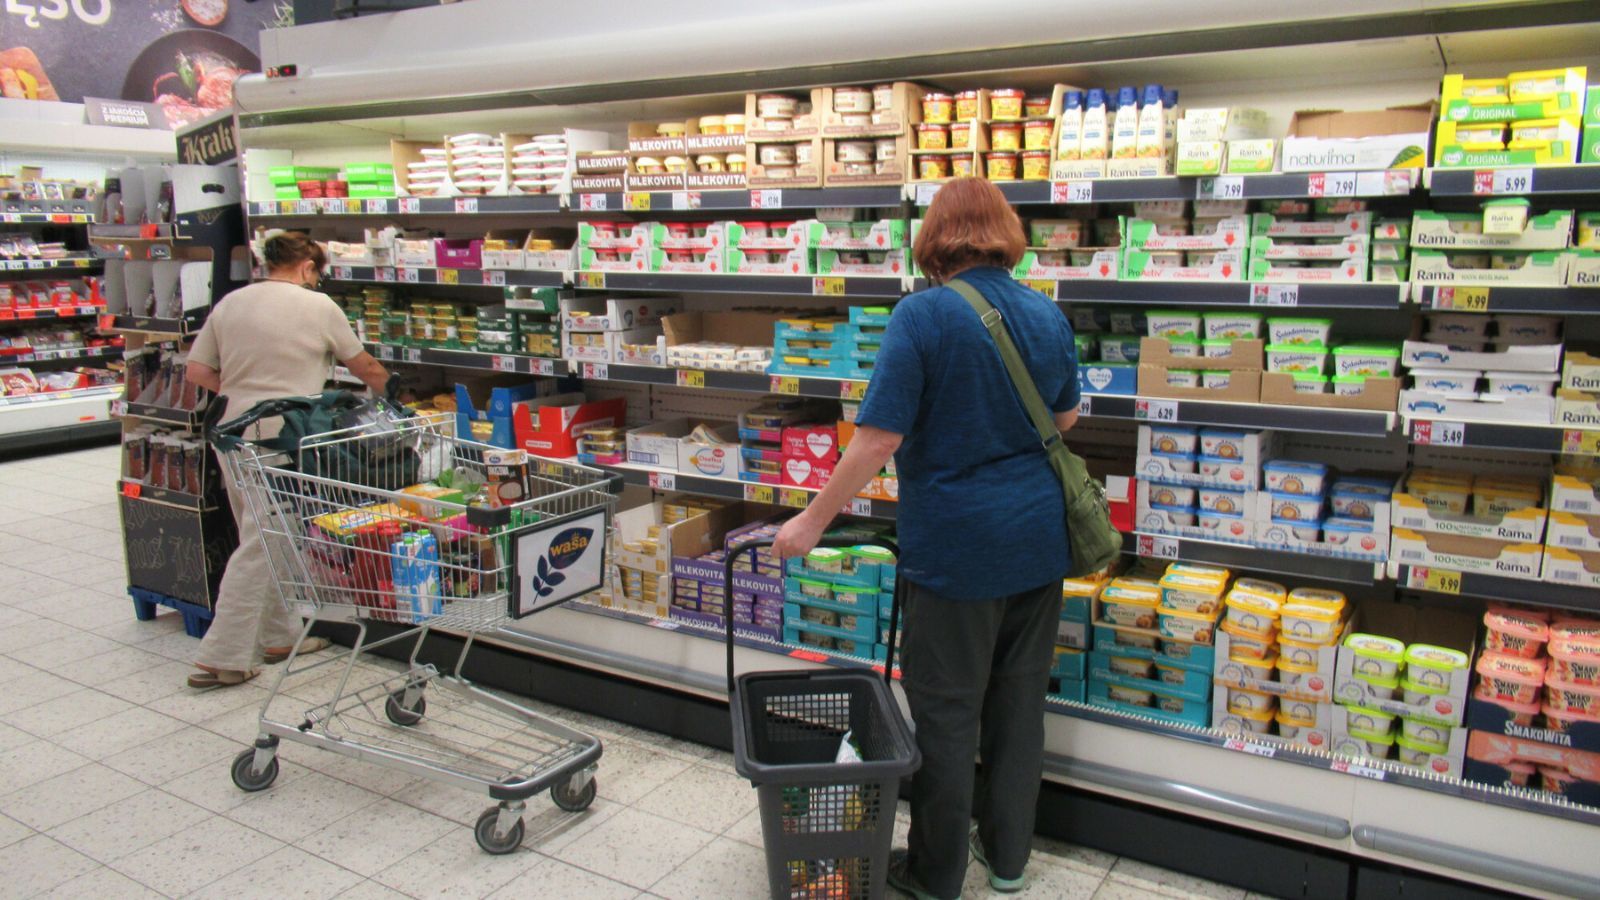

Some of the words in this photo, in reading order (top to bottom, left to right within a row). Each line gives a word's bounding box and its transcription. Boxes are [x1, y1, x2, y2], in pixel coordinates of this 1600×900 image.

[104, 114, 149, 125] PREMIUM
[1473, 109, 1517, 119] ORIGINAL
[629, 139, 684, 152] MLEKOVITA
[688, 135, 746, 149] MLEKOVITA
[578, 157, 628, 168] MLEKOVITA
[1290, 148, 1355, 167] naturima
[1466, 153, 1510, 164] ORIGINAL
[1056, 170, 1082, 179] Rama
[1110, 168, 1138, 178] Rama
[572, 178, 622, 189] MLEKOVITA
[629, 175, 683, 186] MLEKOVITA
[688, 174, 746, 186] MLEKOVITA
[1506, 177, 1526, 192] 5.99
[1225, 184, 1241, 197] 7.99
[1336, 181, 1353, 194] 7.99
[1076, 189, 1090, 200] 7.59
[1131, 240, 1166, 248] ProActiv
[1418, 232, 1456, 245] Rama
[1015, 269, 1047, 277] ProActiv
[1128, 270, 1163, 278] ProActiv
[1416, 270, 1455, 282] Rama
[1466, 296, 1487, 308] 9.99
[1572, 376, 1600, 388] Ram
[1158, 408, 1173, 420] 6.29
[1414, 424, 1430, 432] VAT
[1442, 430, 1462, 443] 5.49
[1422, 496, 1448, 508] Rama
[1498, 527, 1533, 541] Rama
[550, 536, 588, 556] wasa
[1162, 546, 1177, 556] 6.29
[674, 564, 725, 580] MLEKOVITA
[1496, 560, 1531, 574] Rama
[1440, 577, 1459, 590] 9.99
[736, 628, 775, 642] EKOVITA
[1502, 632, 1527, 646] SMAKO
[1504, 642, 1523, 652] WITA
[1571, 663, 1598, 674] SMAKO
[1575, 671, 1594, 680] WITA
[1494, 678, 1520, 691] SMAKO
[1496, 687, 1516, 696] WITA
[1564, 691, 1591, 703] SMAKO
[1568, 700, 1585, 709] WITA
[1504, 720, 1571, 746] SMAKOWITA
